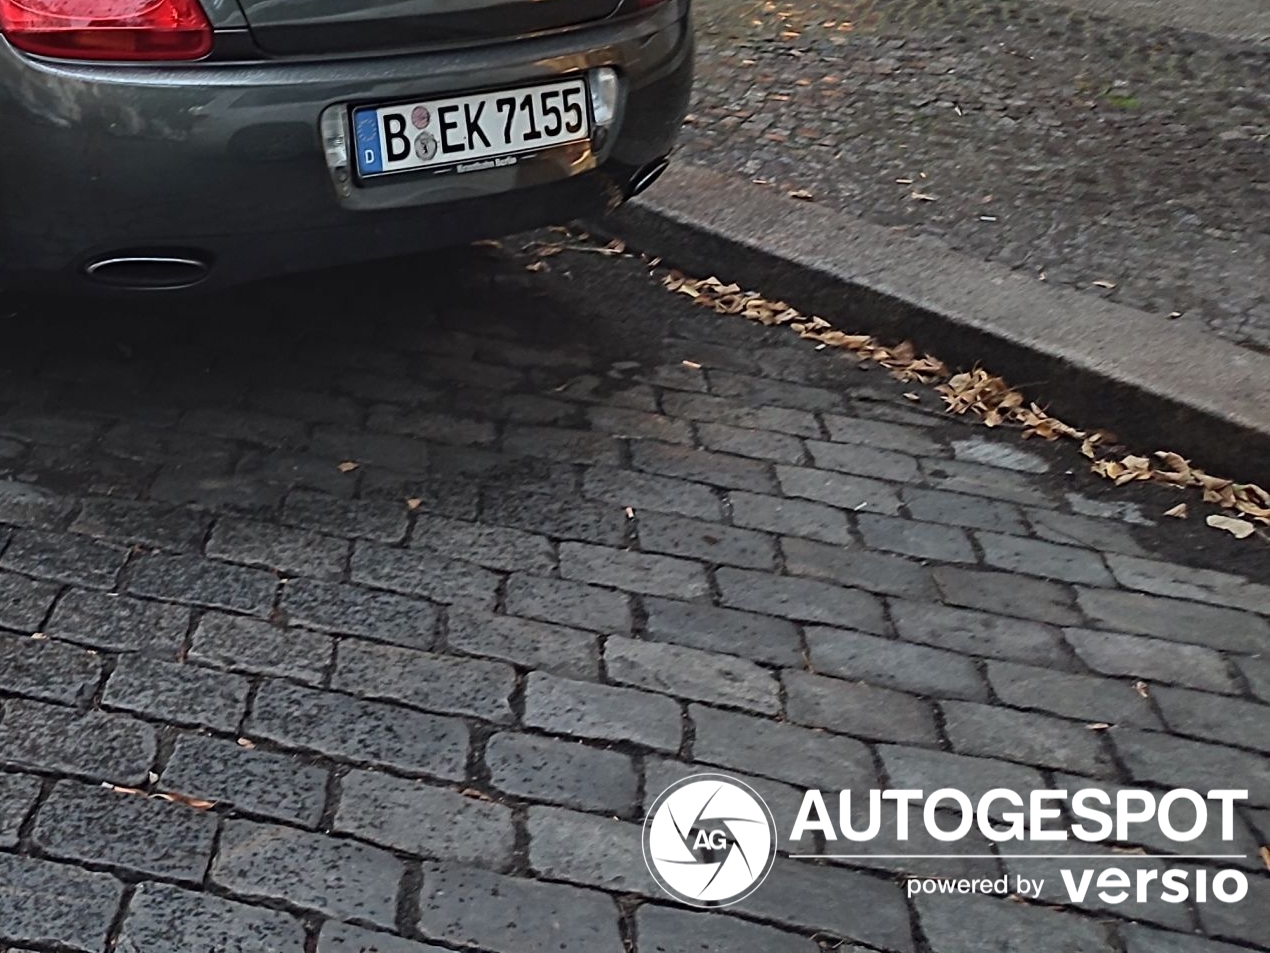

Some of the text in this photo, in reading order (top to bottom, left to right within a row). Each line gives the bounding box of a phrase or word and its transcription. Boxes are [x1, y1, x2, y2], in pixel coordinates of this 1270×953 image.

[365, 87, 583, 164] D B EK 7155
